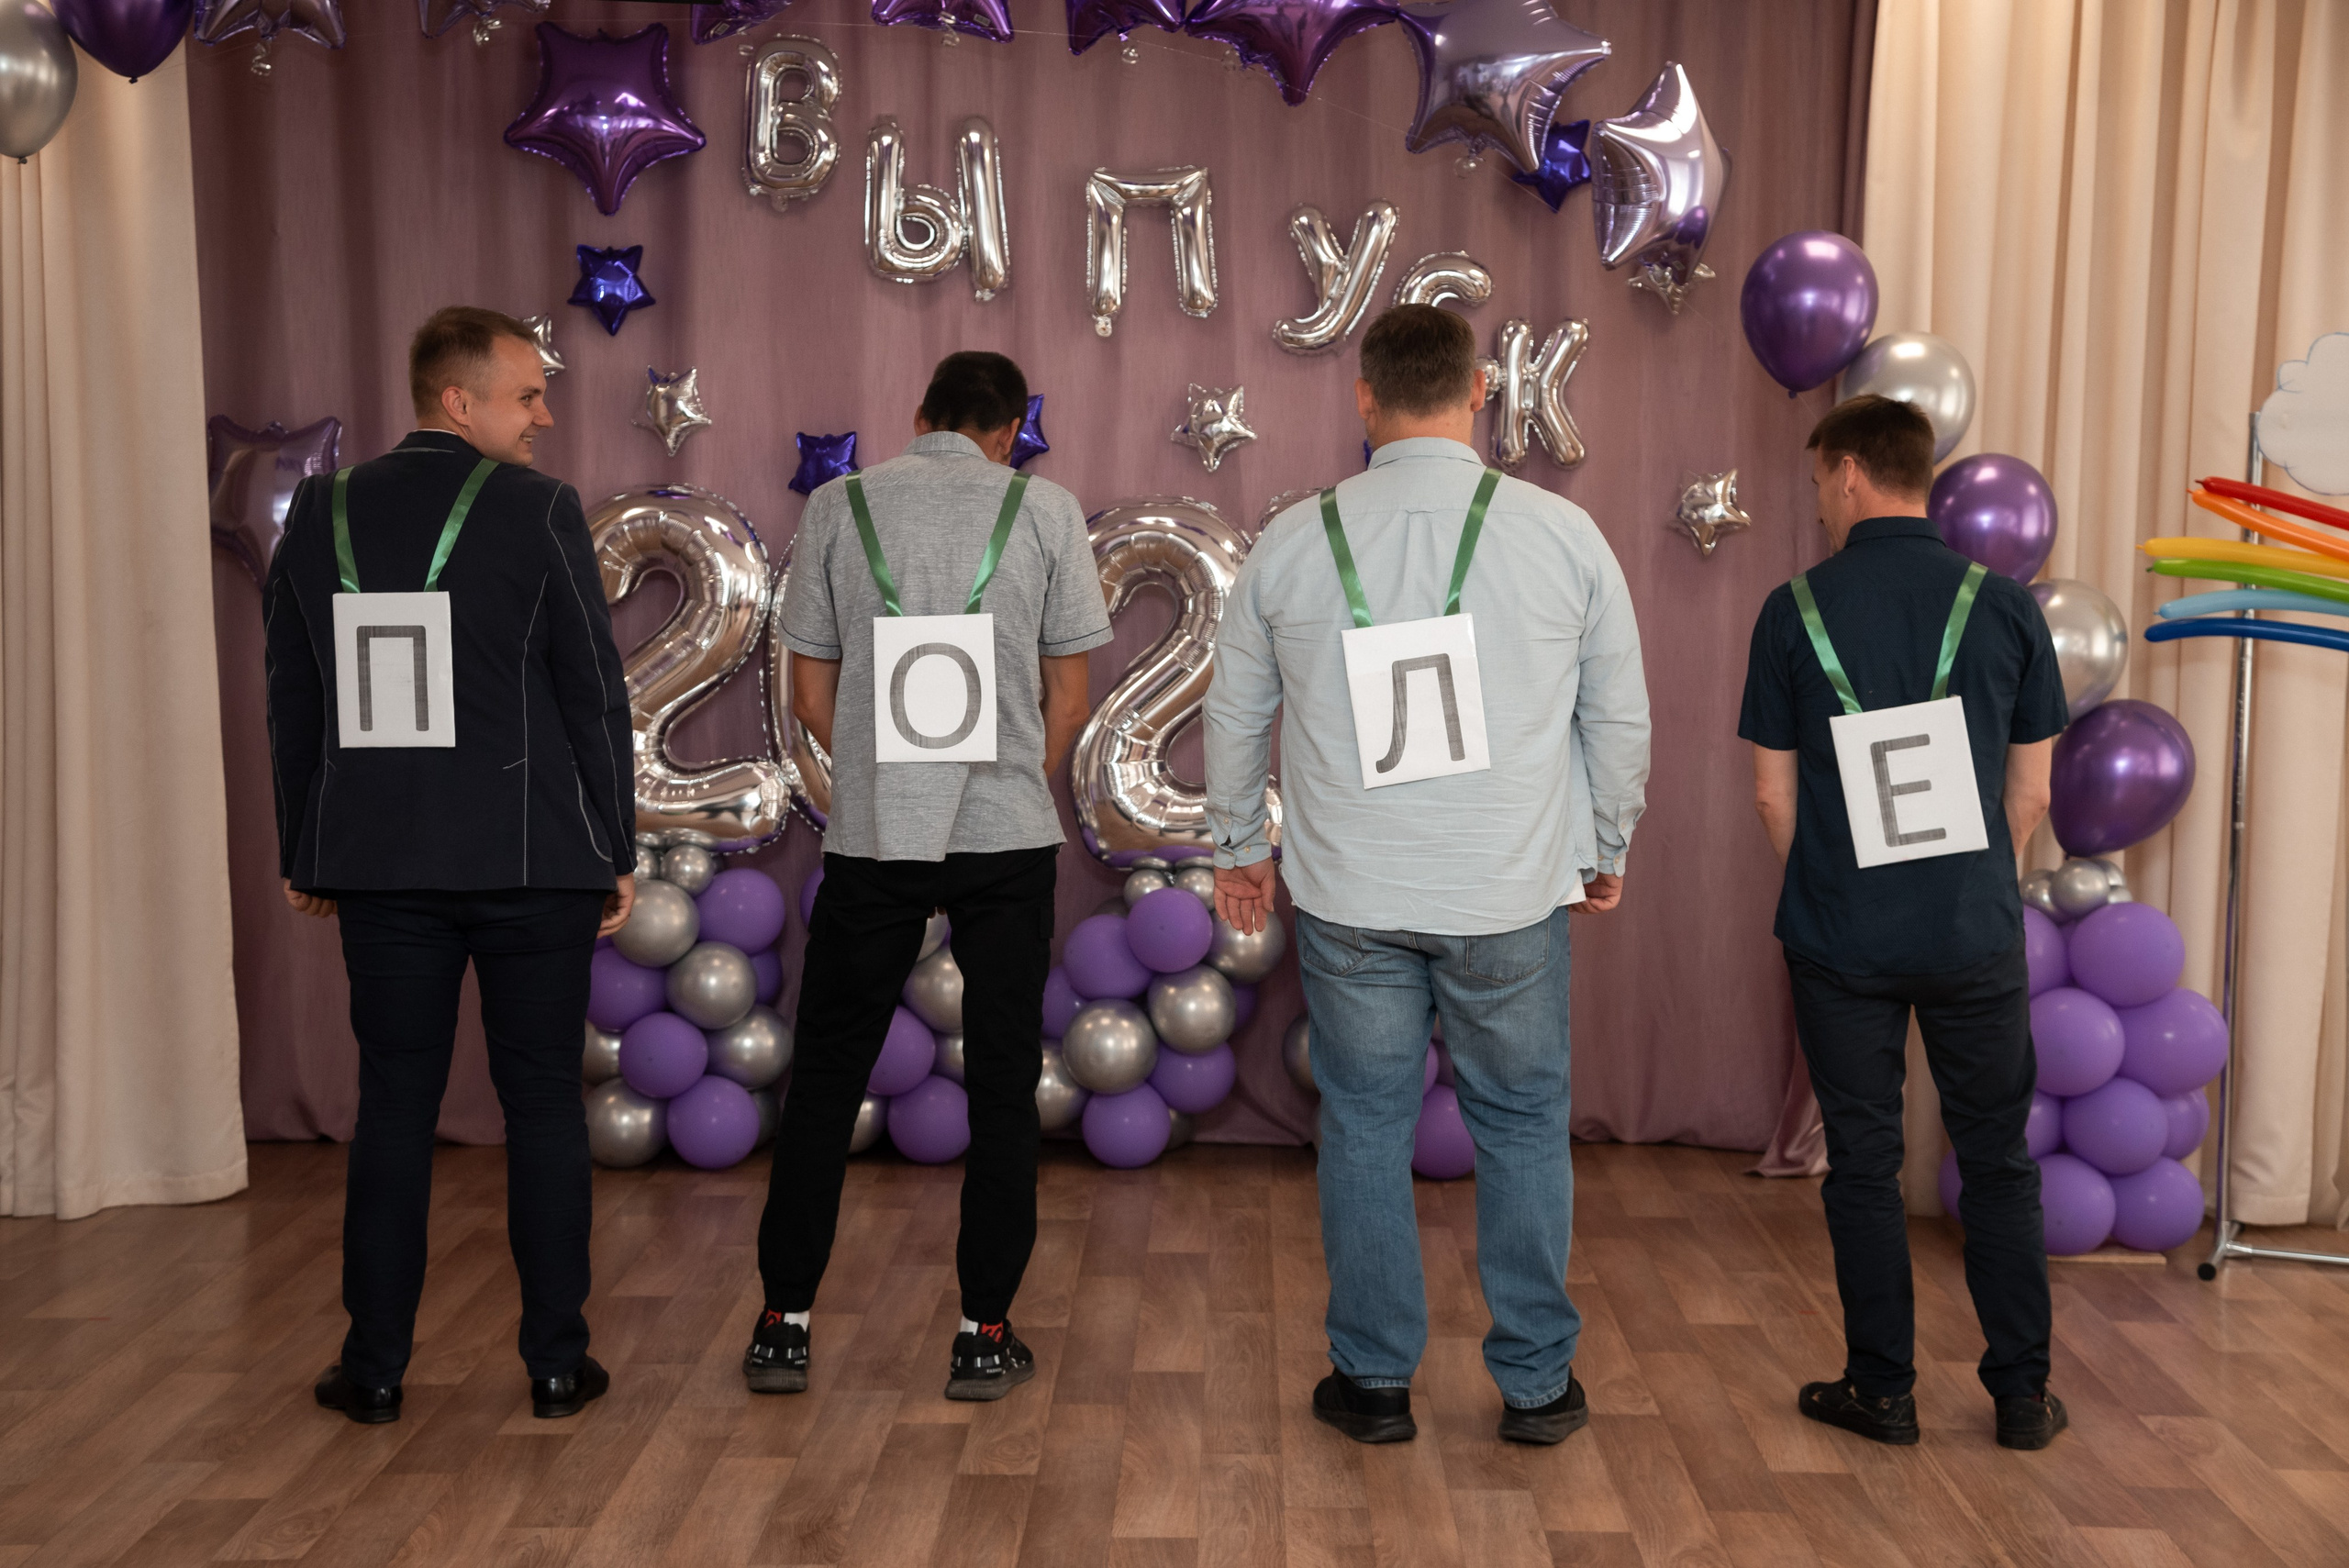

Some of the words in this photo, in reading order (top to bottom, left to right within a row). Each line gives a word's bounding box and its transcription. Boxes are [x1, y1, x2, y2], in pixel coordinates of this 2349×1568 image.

[357, 625, 429, 732] П
[889, 642, 982, 750] О
[1375, 652, 1466, 773] Л
[1870, 733, 1946, 848] Е
